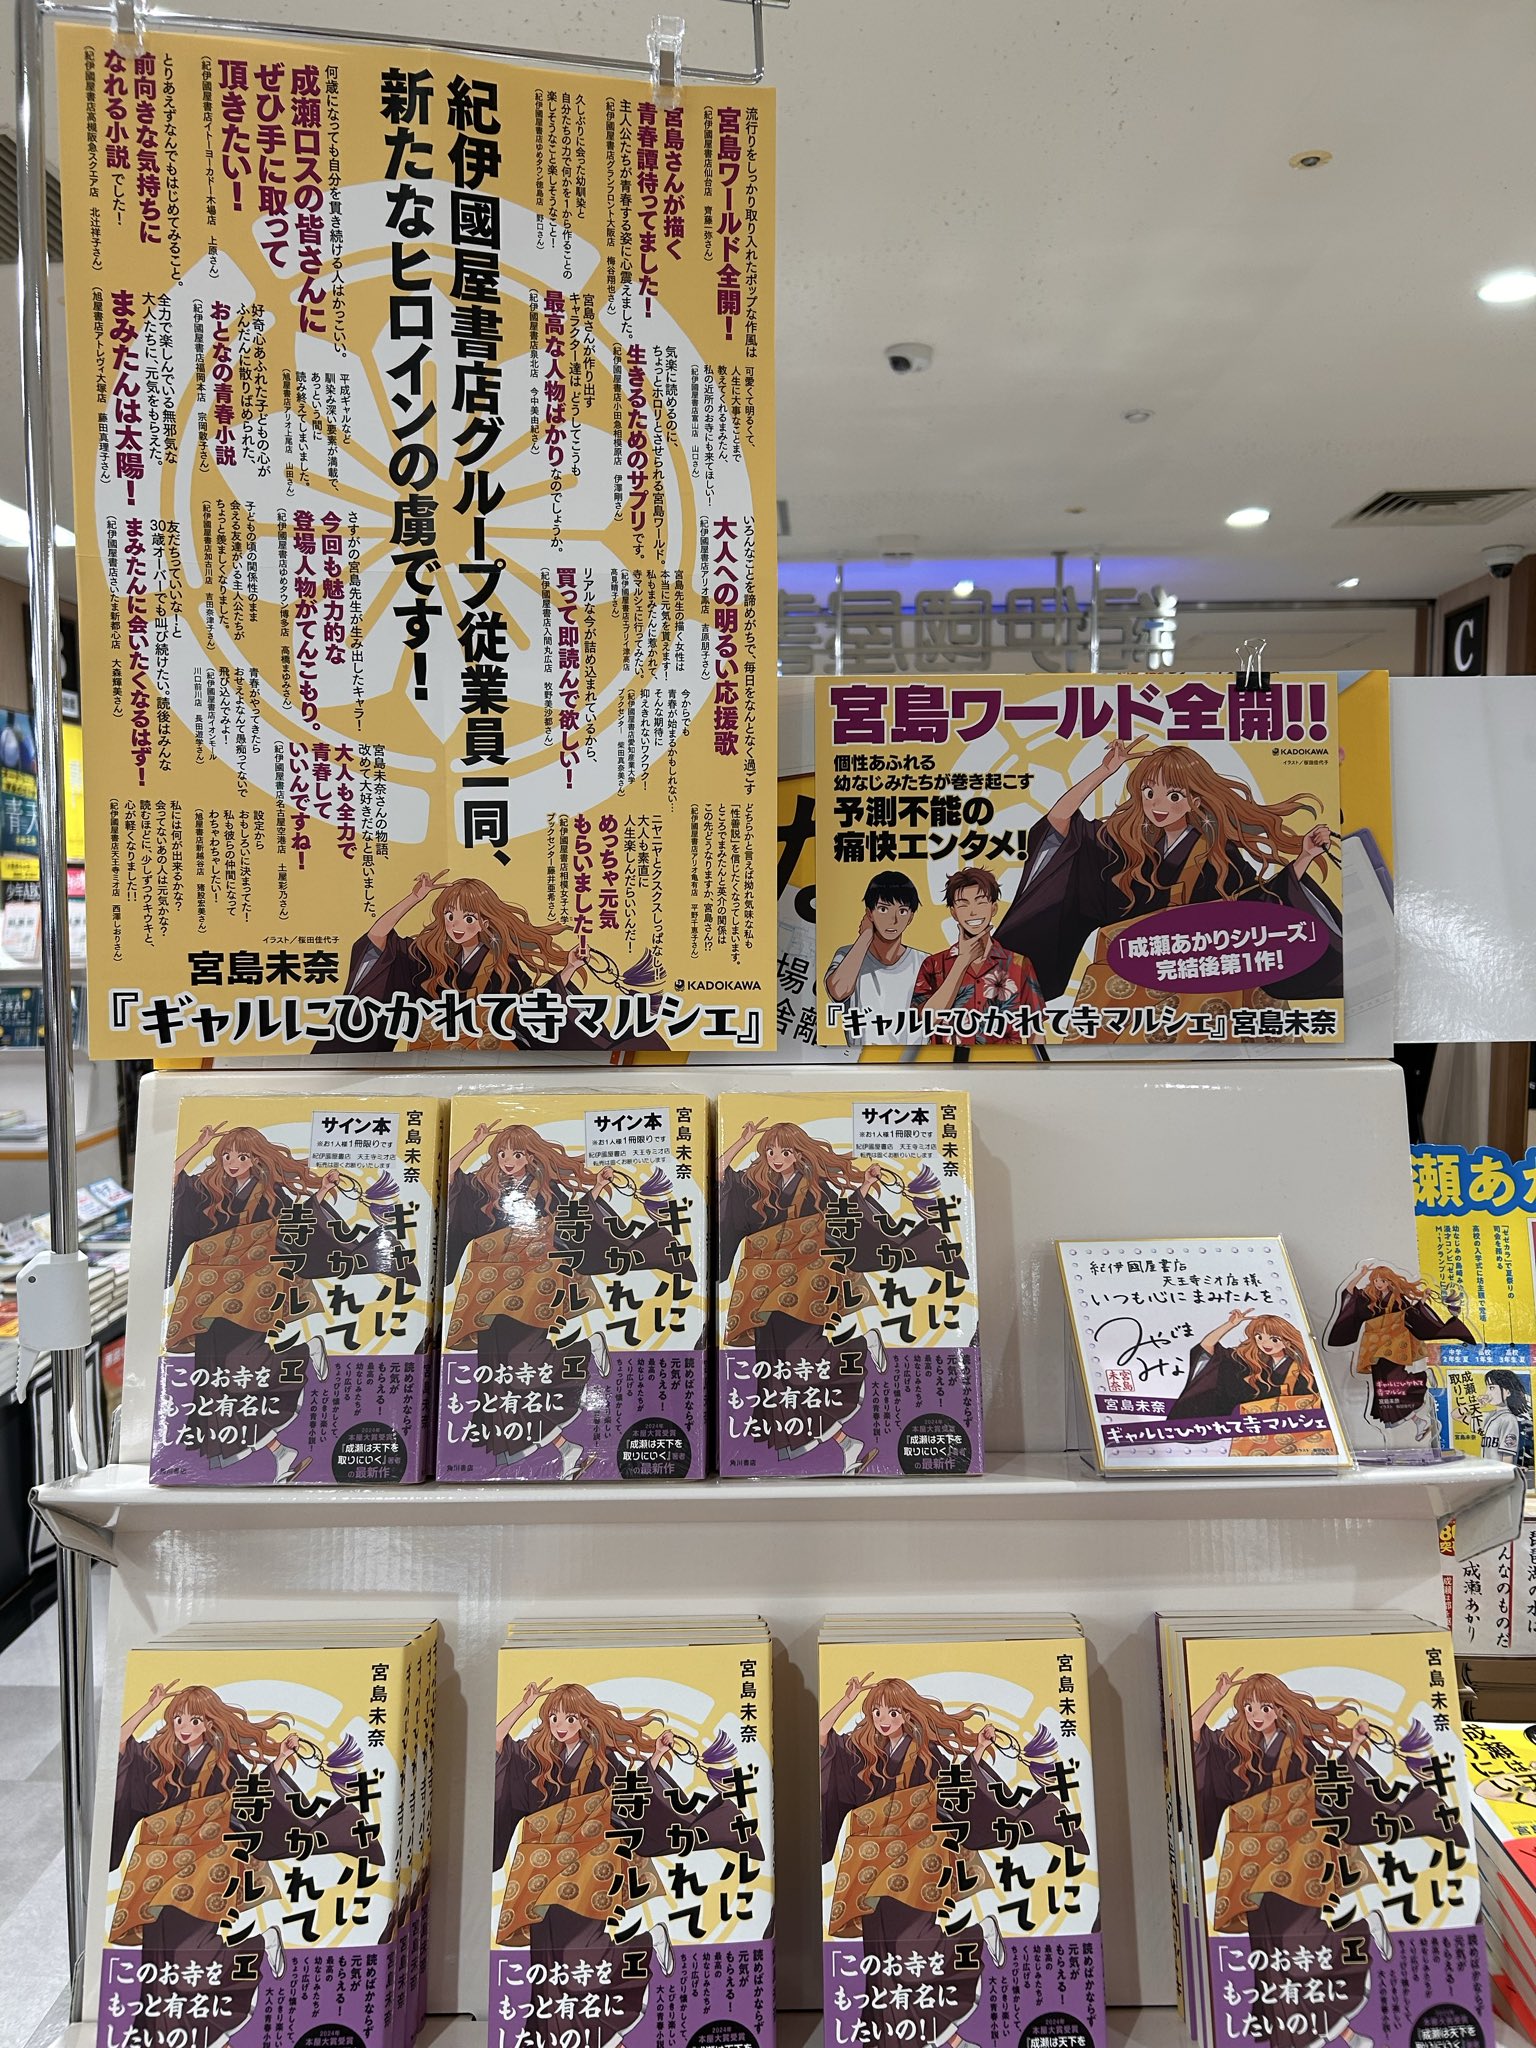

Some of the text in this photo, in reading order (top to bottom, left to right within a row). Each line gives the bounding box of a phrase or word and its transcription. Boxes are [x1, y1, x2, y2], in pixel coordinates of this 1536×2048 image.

[133, 53, 161, 243] 前向きな気持ちに
[163, 53, 183, 288] とりあえずなんでもはじめてみること。
[218, 59, 252, 211] 頂きたい！
[254, 62, 289, 268] ぜひ手に取って
[547, 91, 558, 248] 楽しそうなこと楽しそうなこと！
[575, 94, 586, 219] 久しぶりに会った幼馴染と
[663, 105, 686, 260] 宮島さんが描く
[290, 64, 327, 333] 成瀬ロスの皆さんに
[325, 65, 347, 358] 何歳になっても自分を貫き続ける人はかっこいい。
[619, 99, 633, 339] 主人公たちが青春する姿に心震えました。
[637, 101, 659, 318] 青春譚待ってました！
[716, 107, 742, 340] 宮島ワールド全開！
[745, 107, 758, 358] 流行りをしっかり取り入れたポップな作風は
[109, 290, 144, 506] まみたんは太陽！
[142, 292, 163, 465] 大人たちに、元気をもらえた。
[156, 293, 178, 465] 全力で楽しんでいる無邪気な
[210, 300, 237, 466] おとなの青春小説
[237, 303, 256, 464] ふんだんに散りばめられた、
[251, 303, 271, 477] 好奇心あふれた子どもの心が
[311, 372, 322, 440] あっという間に
[381, 68, 442, 700] 新たなヒロインの虜です！
[583, 293, 596, 408] 宮島さんが作り出す
[664, 346, 678, 447] 気楽に読めるのに、
[745, 367, 755, 447] 可愛くて明るくて、
[296, 371, 310, 486] 読み終えてしまいました。
[325, 373, 340, 491] 馴染み深い要素が満載で、
[338, 374, 351, 444] 平成ギャルなど
[651, 345, 667, 565] ちょっとホロリとさせられる宮島ワールド。
[704, 365, 715, 506] 私の近所のお寺にも来てほしい！
[717, 365, 728, 462] 教えてくれるまみたん、
[731, 366, 741, 462] 人生に大事なことまで
[446, 74, 511, 866] 紀伊國屋書店グループ従業員一同、
[165, 520, 184, 638] 友だちっていいな！と
[230, 500, 246, 640] 会える友達がいる主人公たちが
[244, 501, 258, 622] 子どもの頃の関係性のまま
[321, 511, 347, 665] 今回も魅力的な
[124, 518, 152, 786] まみたんに会いたくなるはず！
[292, 510, 321, 731] 登場人物がてんこもり。
[348, 511, 366, 731] さすがの宮島先生が生み出したキャラ！
[583, 568, 598, 762] リアルな今が詰め込まれているから、
[632, 570, 645, 679] 寺マルシェに行ってみたい。
[673, 569, 686, 671] 宮島先生の描く女性は
[713, 516, 739, 756] 大人への明るい応援歌
[1454, 618, 1474, 672] C
[217, 666, 231, 744] 飛び込んでみよ！
[249, 667, 262, 753] 青春がやってきたら
[557, 568, 580, 789] 買って即読んで欲しい！
[654, 689, 663, 746] そんな期待に
[680, 689, 691, 737] 今からでも
[831, 685, 1328, 745] 宮島ワールド全開!!
[289, 742, 311, 870] いいんですね！
[311, 742, 331, 819] 青春して
[334, 743, 357, 859] 大人も全力で
[371, 744, 389, 862] 宮島未奈さんの物語、
[833, 754, 935, 772] 個性あふれる
[833, 772, 1035, 792] 幼なじみたちが巻き起こす
[833, 796, 994, 828] 予測不能の
[140, 800, 154, 947] 読むほどに、少しずつウキウキと、
[155, 800, 169, 936] 会ってないあの人は元気かな？
[170, 800, 184, 911] 私には何が出来るかな？
[209, 809, 221, 903] わちゃわちゃしたい！
[223, 810, 236, 916] 私も彼らの仲間になって
[239, 810, 251, 922] おもしろいに決まってた！
[358, 743, 376, 918] 改めて大好きだなと思いました。
[573, 813, 593, 955] もらいました！
[598, 814, 619, 929] めっちゃ元気
[624, 814, 636, 953] 人生楽しんだらいいんだ！
[638, 814, 650, 888] 大人も素直に
[717, 803, 727, 944] ところでまみたんと英介の関係は
[833, 831, 1028, 862] 痛快エンタメ!
[188, 950, 340, 985] 宮島未奈
[688, 981, 761, 990] KADOKAWA
[1118, 920, 1318, 960] 「成瀬あかりシリーズ」
[1156, 951, 1285, 982] 完結後第1作!
[112, 990, 762, 1046] 『ギャルにひかれて寺マルシェ』
[827, 1004, 1337, 1039] 『ギャルにひかれて寺マルシェ』 宮島未奈
[321, 1117, 391, 1135] サイン本
[403, 1110, 423, 1183] 宮島未奈
[594, 1115, 663, 1132] サイン本
[675, 1107, 692, 1179] 宮島未奈
[862, 1107, 930, 1125] サイン本
[940, 1105, 959, 1176] 宮島未奈
[267, 1203, 317, 1383] 寺マルシェ
[326, 1219, 370, 1350] ひかれて
[375, 1201, 419, 1337] ギャルに
[548, 1199, 593, 1379] 寺マルシェ
[603, 1214, 646, 1346] ひかれて
[654, 1197, 693, 1332] ギャルに
[819, 1197, 863, 1375] 寺マルシェ
[873, 1212, 917, 1343] ひかれて
[927, 1194, 965, 1330] ギャルに
[1090, 1259, 1187, 1275] 紀伊國屋書店
[447, 1361, 553, 1385] 「このお寺を
[447, 1392, 563, 1413] もっと有名に
[726, 1357, 831, 1381] 「このお寺を
[727, 1389, 843, 1410] もっと有名に
[1104, 1398, 1165, 1413] 宮島未奈
[447, 1421, 543, 1444] したいの!」
[727, 1417, 824, 1439] したいの!」
[1105, 1413, 1328, 1443] ギャルにひかれて寺マルシェ
[1462, 1560, 1483, 1642] 成瀬あかり
[367, 1663, 390, 1746] 宮島未奈
[739, 1659, 758, 1742] 宮島未奈
[1057, 1653, 1077, 1737] 宮島未奈
[1425, 1647, 1449, 1731] 宮島未奈
[217, 1773, 274, 1981] 寺マルシェ
[282, 1792, 332, 1943] ひかれて
[336, 1769, 385, 1926] ギャルに
[605, 1770, 653, 1978] 寺マルシェ
[664, 1788, 709, 1938] ひかれて
[720, 1764, 760, 1921] ギャルに
[931, 1763, 980, 1970] 寺マルシェ
[988, 1781, 1036, 1932] ひかれて
[1045, 1757, 1086, 1914] ギャルに
[1312, 1758, 1369, 1965] 寺マルシェ
[1366, 1776, 1421, 1925] ひかれて
[1422, 1752, 1468, 1908] ギャルに
[107, 1993, 233, 2020] もっと有名に
[108, 1956, 223, 1984] 「このお寺を
[497, 1958, 613, 1985] 「このお寺を
[497, 1993, 624, 2020] もっと有名に
[832, 1949, 944, 1978] 「このお寺を
[833, 1984, 958, 2010] もっと有名に
[1056, 1944, 1066, 2007] もらえる！
[1068, 1944, 1079, 1981] 元気が
[1082, 1943, 1096, 2026] 読めばかならず
[1218, 1943, 1333, 1972] 「このお寺を
[1223, 1978, 1348, 2004] もっと有名に
[835, 2016, 936, 2044] したいの!」
[1225, 2011, 1329, 2039] したいの!」
